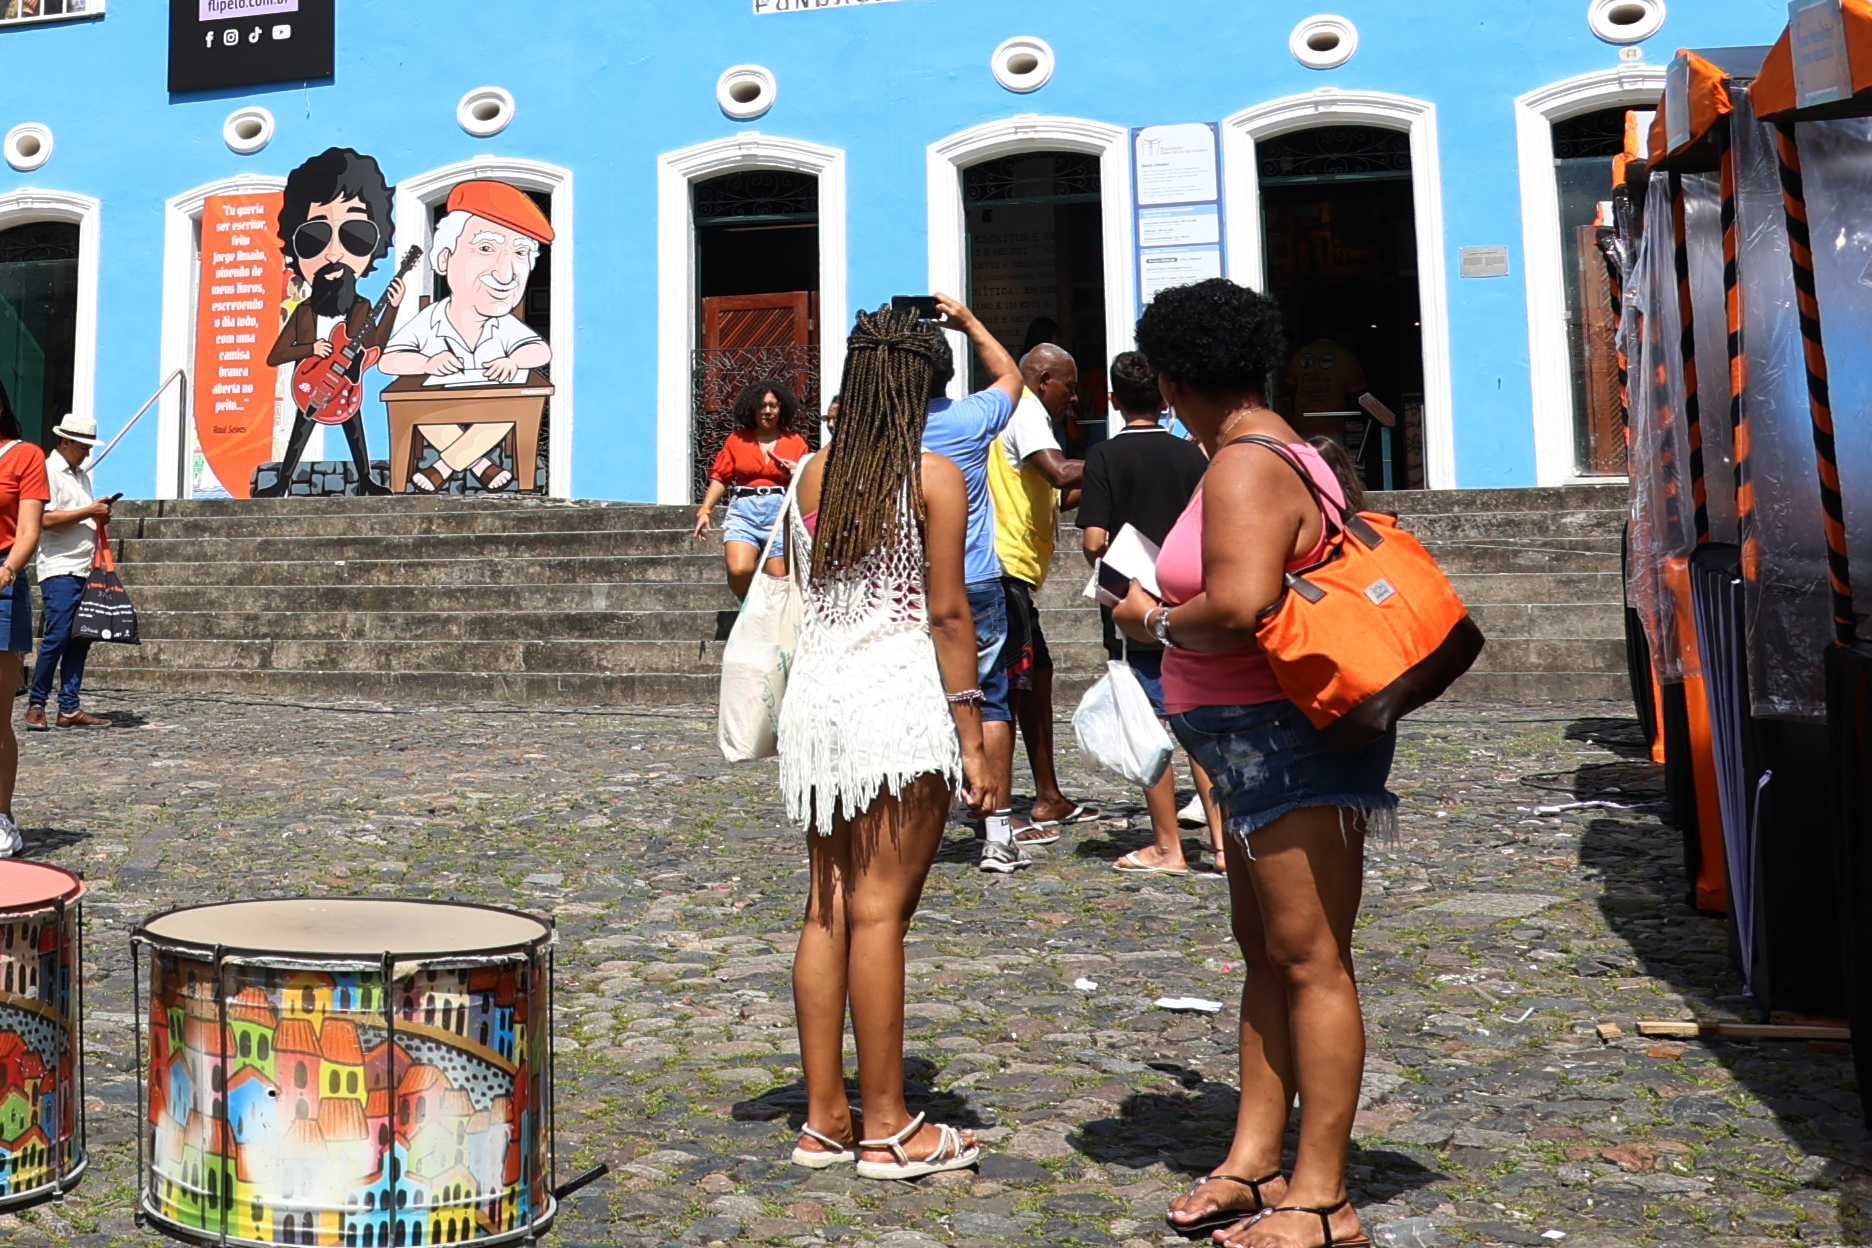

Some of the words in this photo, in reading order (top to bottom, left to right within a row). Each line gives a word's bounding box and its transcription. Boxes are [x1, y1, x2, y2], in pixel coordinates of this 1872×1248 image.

[237, 203, 264, 217] queria
[216, 223, 231, 232] ser
[232, 218, 268, 231] escritor,
[231, 235, 250, 246] feito
[212, 252, 235, 265] Jorge
[237, 249, 267, 261] Amado,
[252, 265, 263, 277] de
[211, 284, 235, 295] meus
[236, 282, 265, 294] livros,
[211, 298, 264, 312] escrevendo
[214, 318, 220, 328] o
[222, 315, 235, 327] dia
[237, 315, 259, 328] todo,
[216, 335, 234, 344] com
[236, 334, 256, 343] uma
[219, 348, 251, 361] camisa
[219, 366, 249, 377] branca
[212, 382, 240, 394] aberta
[241, 384, 254, 393] no
[213, 425, 227, 434] Raul
[228, 425, 247, 434] Seixas
